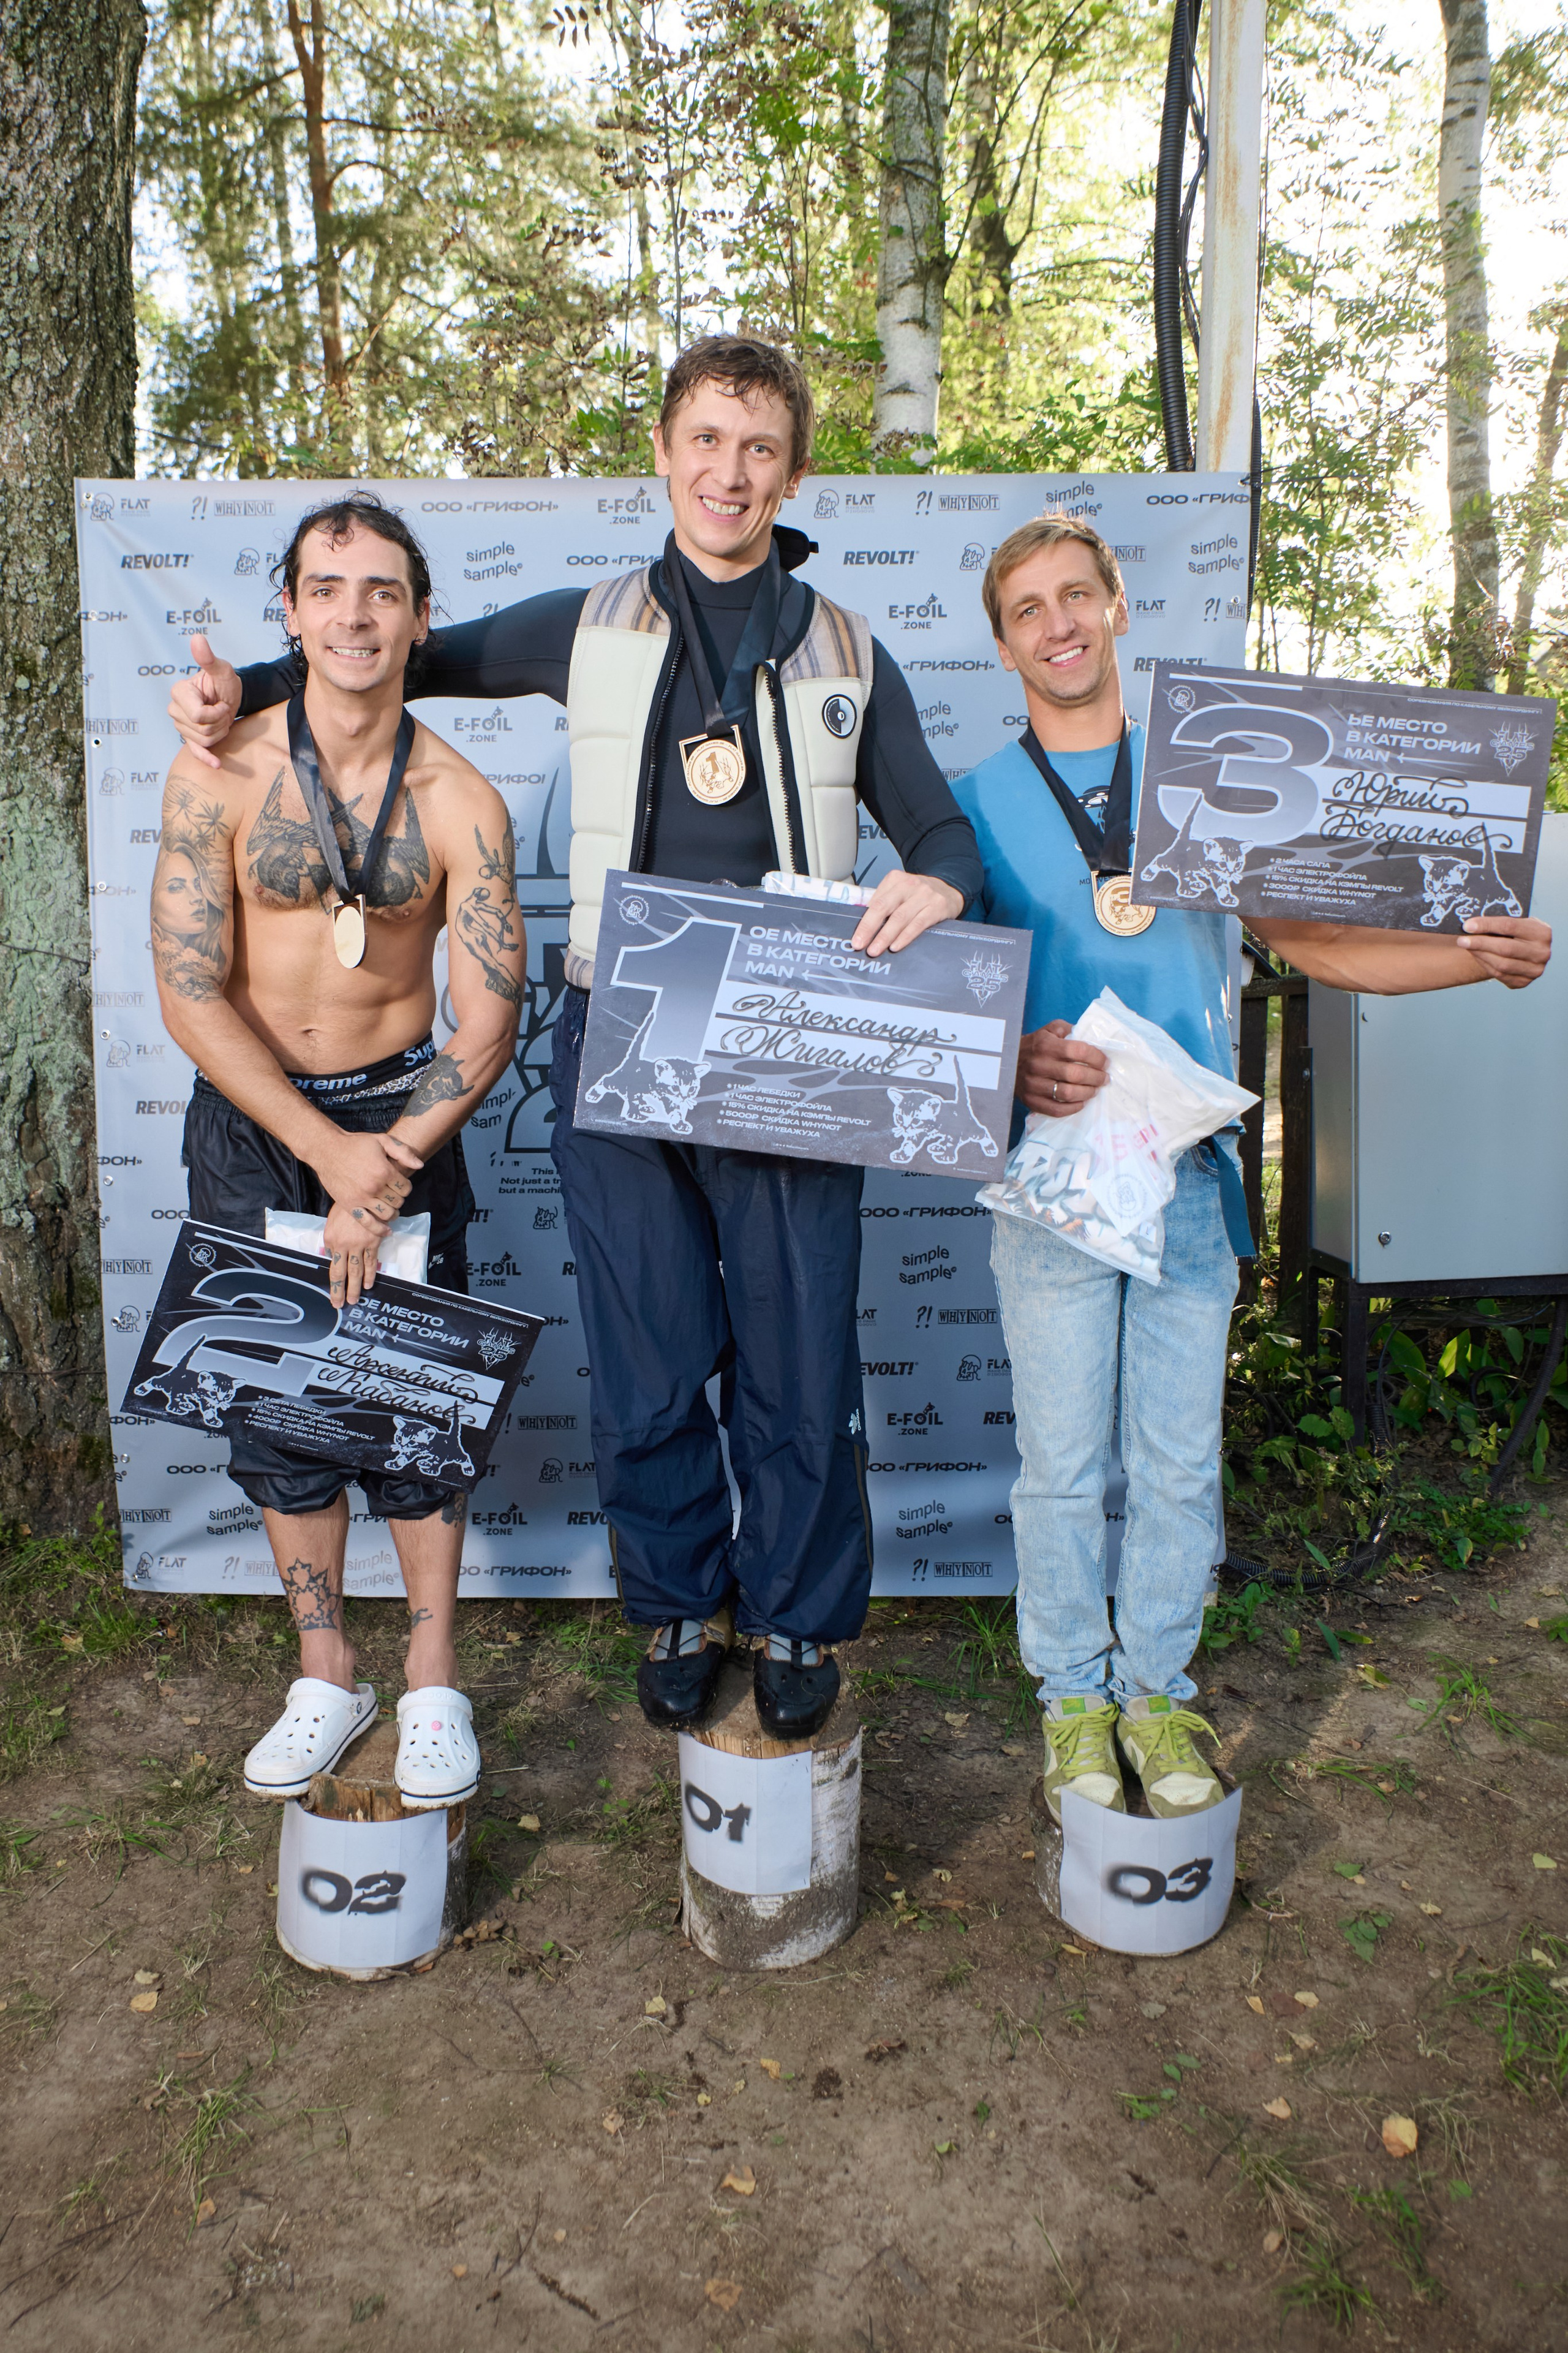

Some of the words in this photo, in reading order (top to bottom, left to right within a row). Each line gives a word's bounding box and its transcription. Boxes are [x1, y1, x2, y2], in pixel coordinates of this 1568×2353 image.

[846, 494, 875, 505] FLAT
[1046, 481, 1095, 503] simple
[1147, 495, 1188, 505] ООО
[1193, 493, 1250, 504] «ГРИФ
[121, 499, 150, 509] FLAT
[215, 501, 274, 515] WHYNOT
[421, 502, 462, 512] ООО
[467, 501, 559, 512] «ГРИФОН»
[598, 499, 656, 513] E-FOIL
[939, 495, 1000, 510] WHYNOT
[466, 541, 514, 562] simple
[1191, 534, 1237, 554] simple
[121, 554, 189, 569] REVOLT!
[567, 556, 608, 565] ООО
[843, 550, 915, 565] REVOLT!
[889, 604, 947, 619] E-FOIL
[1136, 600, 1166, 611] FLAT
[167, 610, 221, 624] E-FOIL
[138, 665, 175, 676] ООО
[903, 661, 995, 671] «ГРИФОН»
[454, 718, 513, 731] E-FOIL
[1348, 714, 1374, 727] ЬЕ
[1376, 716, 1447, 734] МЕСТО
[1346, 730, 1361, 742] В
[1363, 732, 1482, 755] КАТЕГОРИИ
[1490, 739, 1534, 751] GAMES
[1343, 747, 1390, 763] MAN
[1494, 746, 1527, 761] 25
[131, 772, 159, 783] FLAT
[1295, 869, 1367, 880] ЭЛЕКТРОФОЙЛА
[1288, 876, 1324, 885] СКИДКА
[1338, 881, 1371, 889] КЭМПЫ
[1371, 884, 1404, 893] REVOLT
[1266, 891, 1305, 901] РЕСПЕКТ
[1313, 895, 1356, 905] УВАЖУХА
[1302, 886, 1337, 895] СКИДКА
[1339, 889, 1376, 899] WHYNOT
[782, 931, 856, 952] МЕСТО
[930, 930, 969, 939] КАБЕЛЬНОМУ
[747, 943, 763, 956] В
[766, 945, 891, 975] КАТЕГОРИИ
[745, 961, 794, 978] MAN
[962, 969, 1009, 983] GAMES
[966, 976, 1001, 992] 25
[137, 1044, 165, 1055] FLAT
[756, 1087, 801, 1098] ЛЕБЕДКИ
[755, 1095, 832, 1112] ЭЛЕКТРОФОЙЛА
[747, 1104, 785, 1114] СКИДКА
[801, 1111, 836, 1121] КЭМПЫ
[836, 1116, 872, 1126] REVOLT
[723, 1119, 765, 1130] РЕСПЕКТ
[774, 1125, 821, 1138] УВАЖУХА
[761, 1115, 800, 1125] СКИДКА
[801, 1120, 842, 1131] WHYNOT
[522, 1177, 541, 1186] just
[859, 1207, 899, 1217] ООО
[903, 1207, 992, 1217] «ГРИФОН»
[902, 1245, 949, 1266] simple
[380, 1303, 445, 1327] МЕСТО
[938, 1310, 998, 1323] WHYNOT
[343, 1321, 387, 1340] MAN
[349, 1308, 364, 1319] В
[364, 1312, 470, 1348] КАТЕГОРИИ
[478, 1345, 508, 1361] 25
[861, 1362, 913, 1375] EVOLT!
[270, 1398, 290, 1407] СЕТА
[290, 1403, 327, 1415] ЛЕБЕДКИ
[281, 1407, 344, 1427] ЭЛЕКТРОФОЙЛА
[518, 1416, 577, 1430] WHYNOT
[888, 1413, 943, 1426] E-FOIL
[249, 1420, 285, 1432] РЕСПЕКТ
[292, 1429, 331, 1443] УВАЖУХА
[272, 1411, 304, 1424] СКИДКА
[317, 1422, 346, 1433] КЭМПЫ
[346, 1430, 375, 1441] REVOLT
[283, 1421, 315, 1433] СКИДКА
[316, 1429, 350, 1441] WHYNOT
[167, 1465, 206, 1474] ООО
[899, 1462, 987, 1471] «ГРИФОН»
[209, 1503, 254, 1521] simple
[899, 1500, 945, 1521] simple
[472, 1512, 527, 1525] E-FOIL
[158, 1557, 186, 1568] FLAT
[346, 1550, 393, 1571] simple
[484, 1566, 571, 1576] «ГРИФОН»
[935, 1563, 992, 1576] WHYNOT
[1104, 1857, 1213, 1905] 03
[301, 1867, 407, 1916] 02
